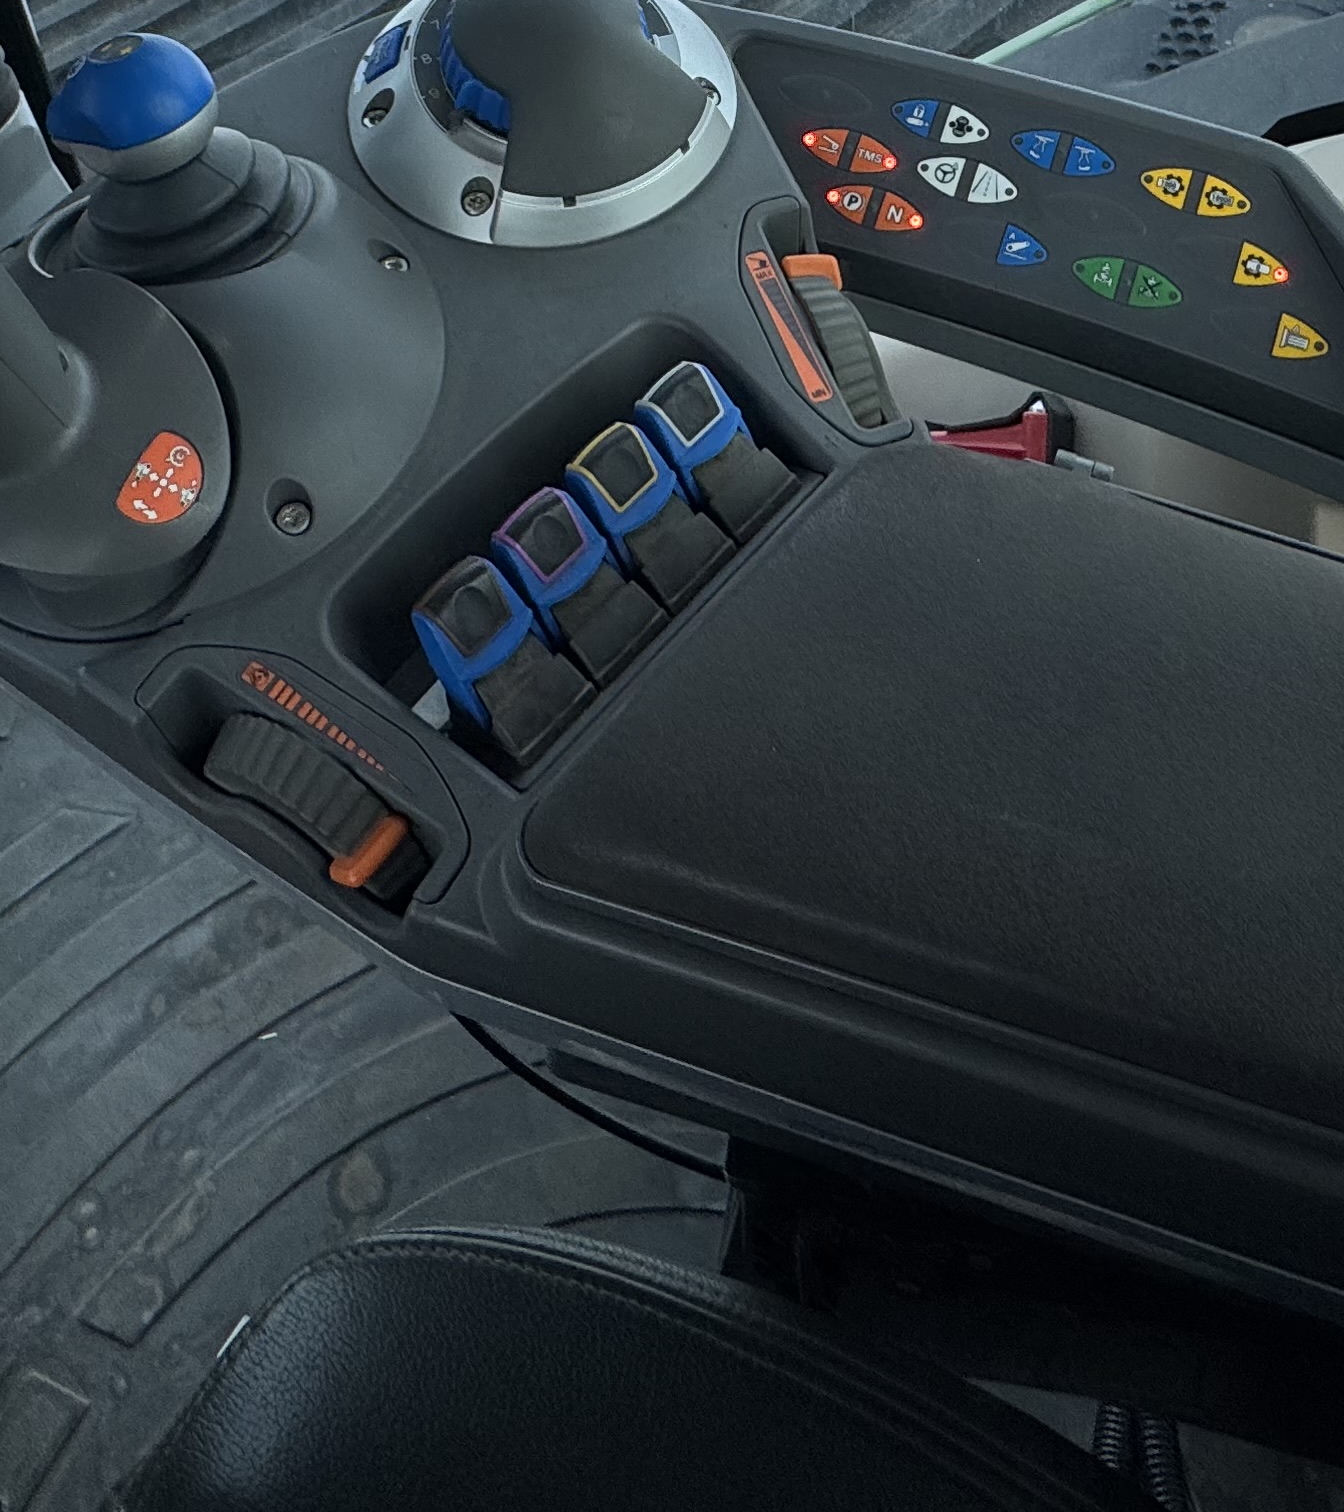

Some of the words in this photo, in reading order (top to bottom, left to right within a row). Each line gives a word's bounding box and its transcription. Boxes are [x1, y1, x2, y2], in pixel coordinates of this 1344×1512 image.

[857, 147, 883, 165] TMS
[846, 194, 860, 207] P
[886, 204, 905, 224] N
[754, 268, 773, 280] MAX
[810, 387, 827, 399] MIN
